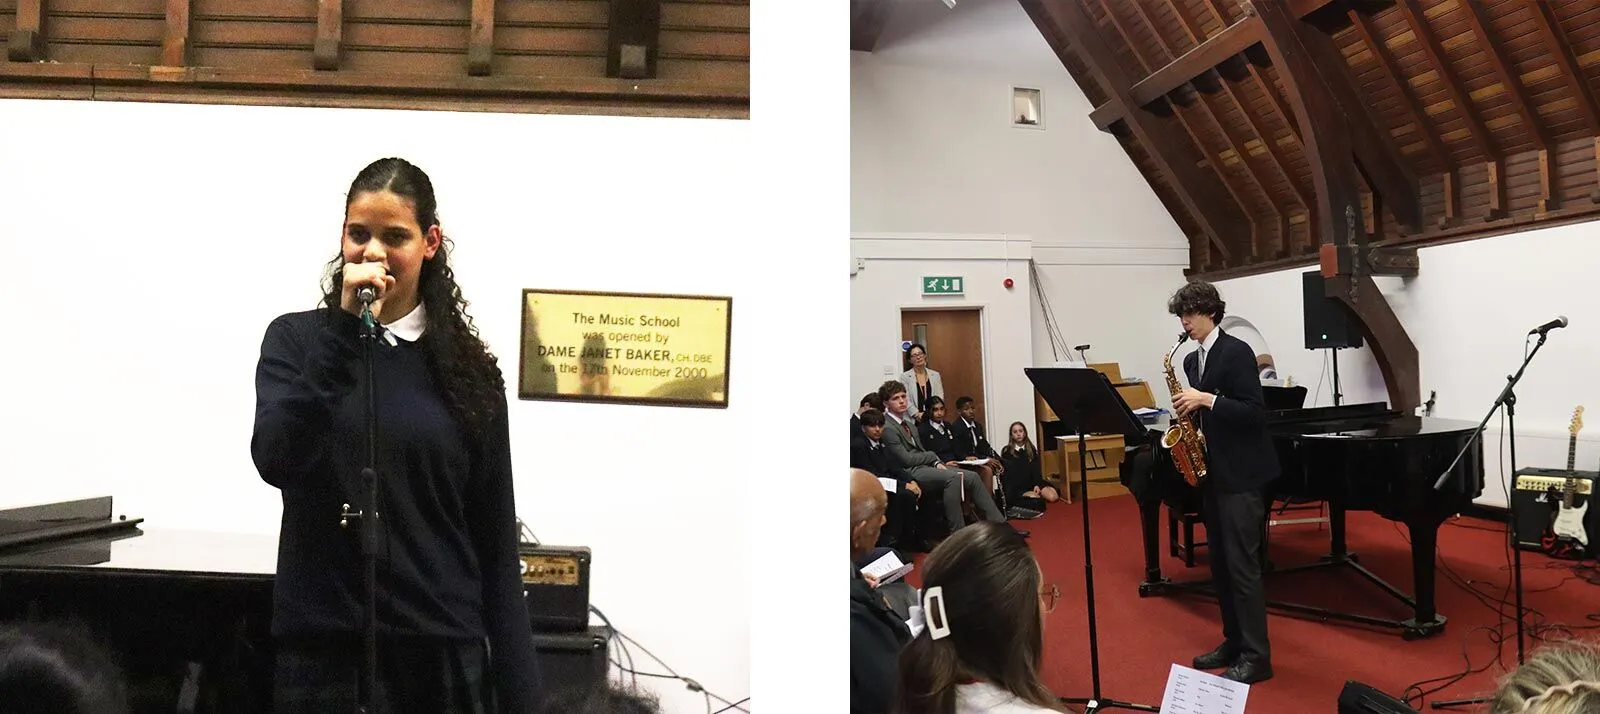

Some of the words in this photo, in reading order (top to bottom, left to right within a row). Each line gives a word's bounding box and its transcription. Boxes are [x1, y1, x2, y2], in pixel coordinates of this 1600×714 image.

[571, 311, 595, 325] The
[599, 313, 635, 326] Music
[639, 314, 681, 328] School
[582, 331, 605, 340] was
[608, 331, 651, 343] opened
[655, 332, 670, 346] by
[537, 345, 576, 358] DAME
[581, 347, 622, 360] JANET
[626, 348, 674, 363] BAKER,
[542, 363, 556, 373] on
[560, 363, 578, 374] the
[582, 363, 608, 375] 17th
[612, 365, 671, 377] November
[675, 366, 708, 379] 2000
